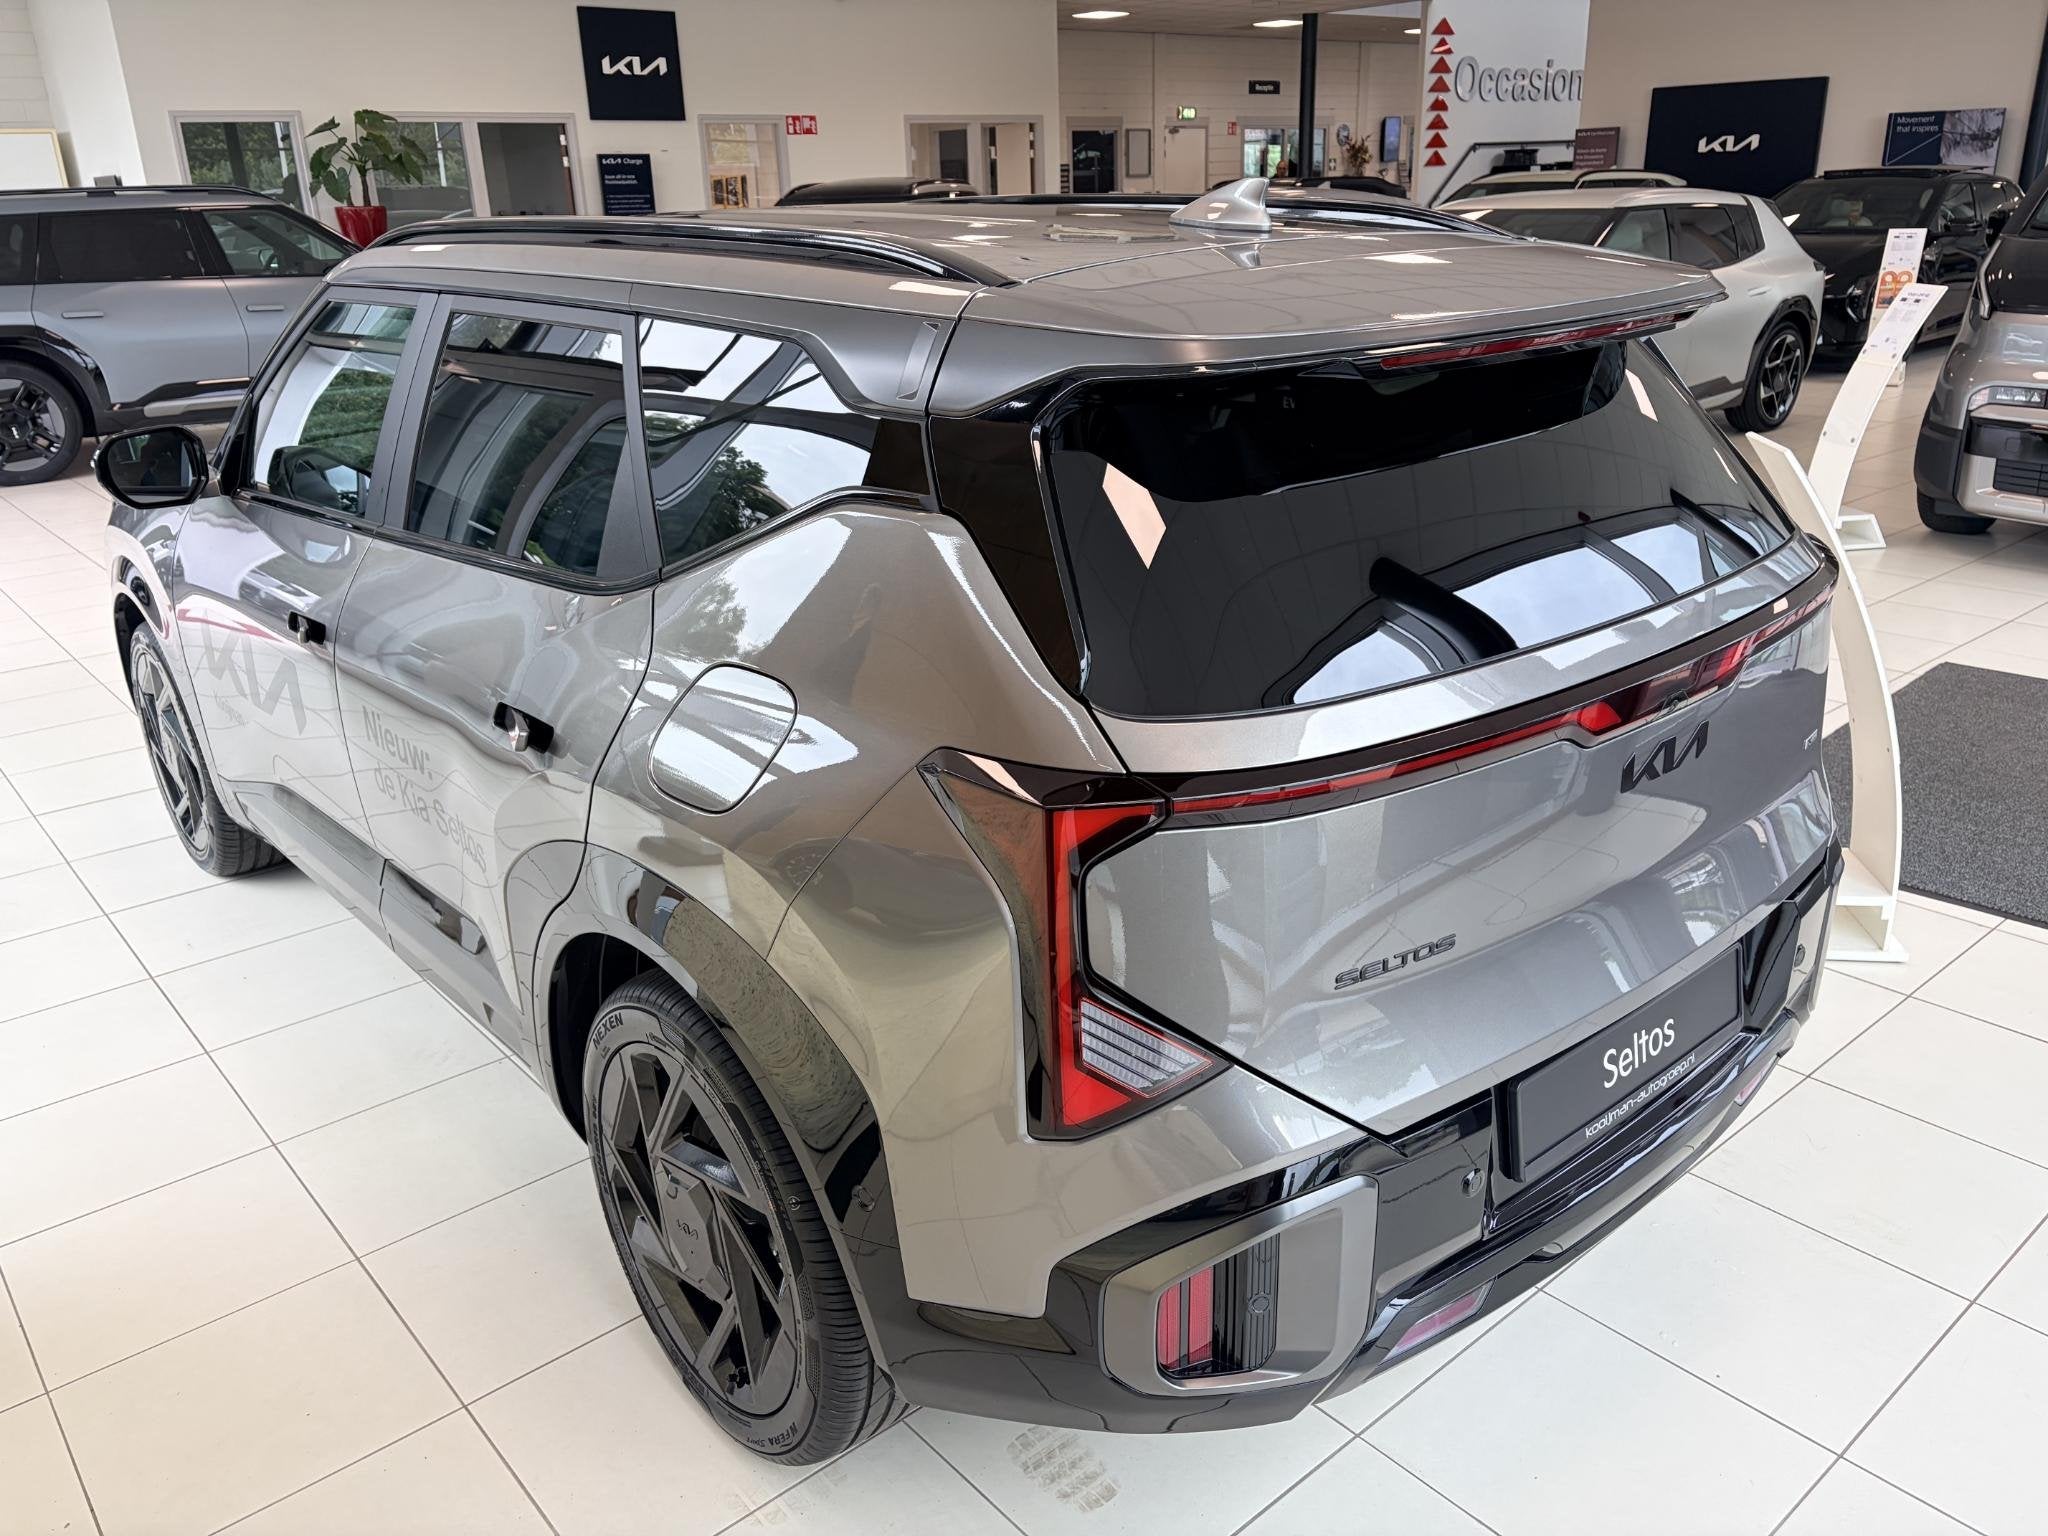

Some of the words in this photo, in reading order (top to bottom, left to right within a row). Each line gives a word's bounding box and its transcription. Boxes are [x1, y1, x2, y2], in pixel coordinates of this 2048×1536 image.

[601, 55, 668, 76] KIA
[1454, 56, 1584, 102] Occasion
[1697, 133, 1761, 153] KIA
[201, 607, 307, 736] KIA
[362, 705, 433, 781] Nieuw:
[1620, 720, 1710, 794] KIA
[374, 761, 397, 801] de
[396, 772, 431, 825] Kia
[433, 799, 488, 874] Seltos
[1334, 933, 1457, 990] SELTOS
[592, 1012, 624, 1051] NEXEN
[1602, 1018, 1676, 1089] Seltos
